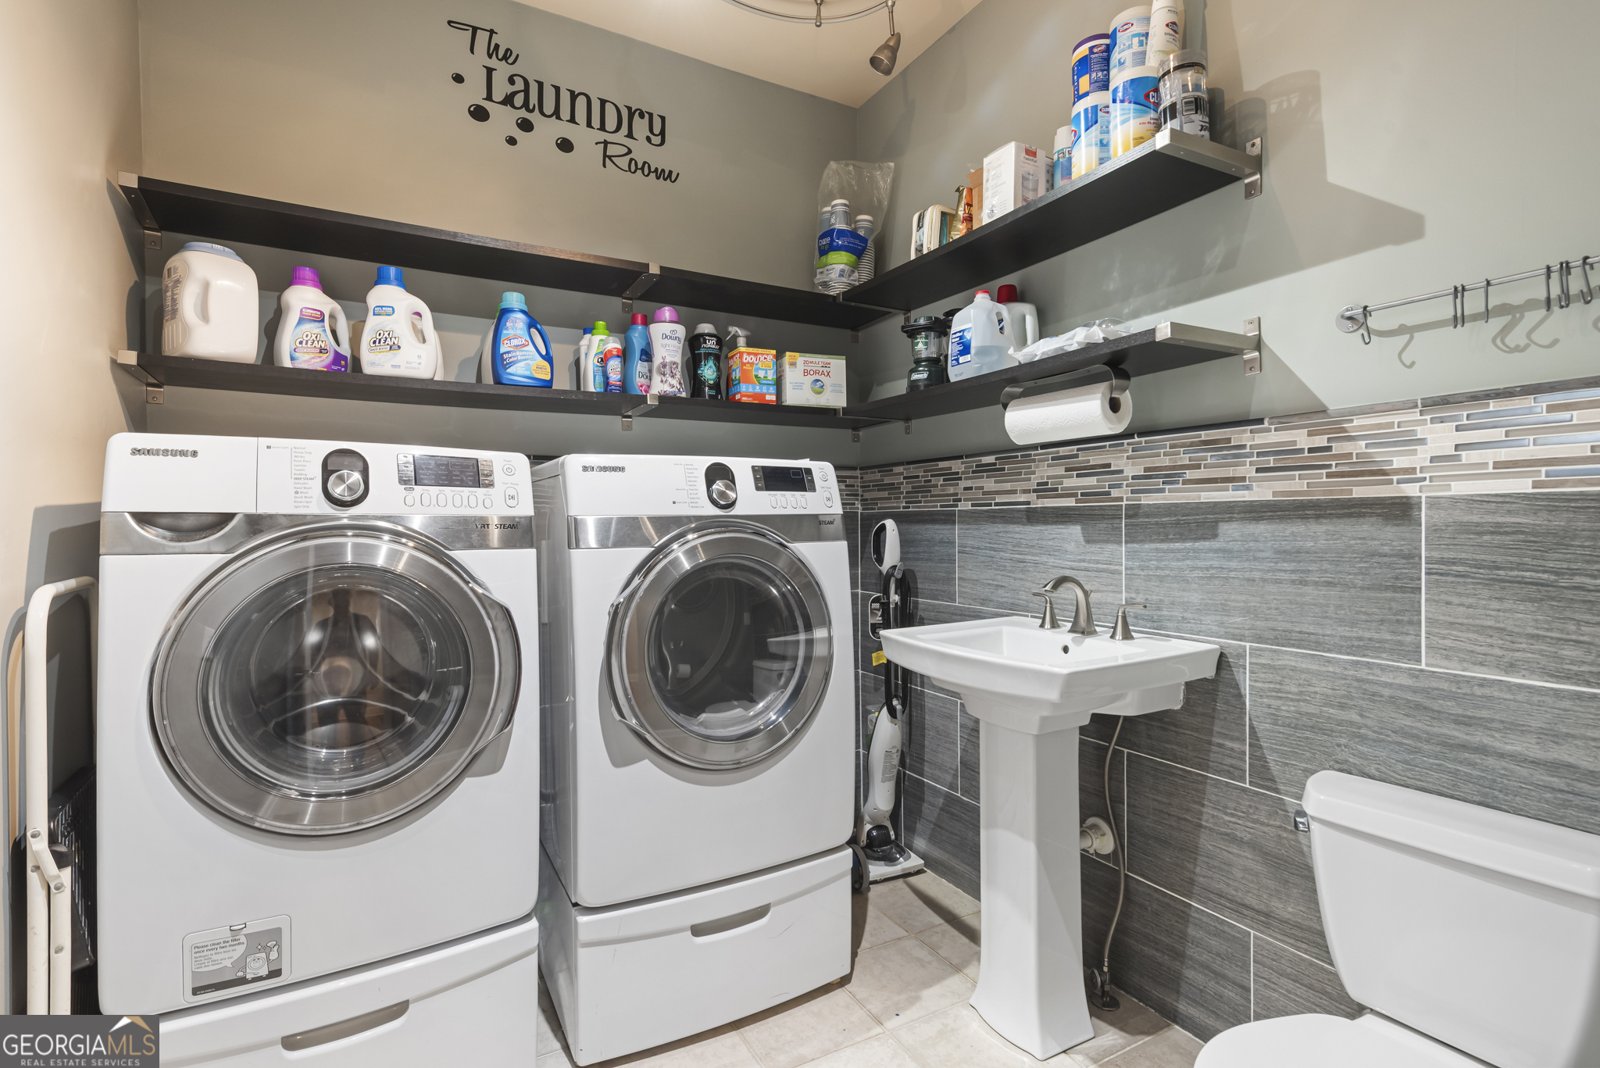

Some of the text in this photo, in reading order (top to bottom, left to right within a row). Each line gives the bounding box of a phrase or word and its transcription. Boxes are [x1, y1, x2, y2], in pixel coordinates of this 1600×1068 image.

[447, 20, 520, 66] The
[482, 65, 666, 147] Laundry
[595, 139, 680, 184] Room
[302, 331, 321, 340] OXI
[376, 329, 393, 339] OXI
[661, 333, 682, 345] Downy
[295, 338, 327, 348] CLEAN
[368, 337, 400, 347] CLEAN
[743, 352, 773, 364] bounce
[803, 368, 832, 379] BORAX
[130, 447, 198, 458] SAMSUNG
